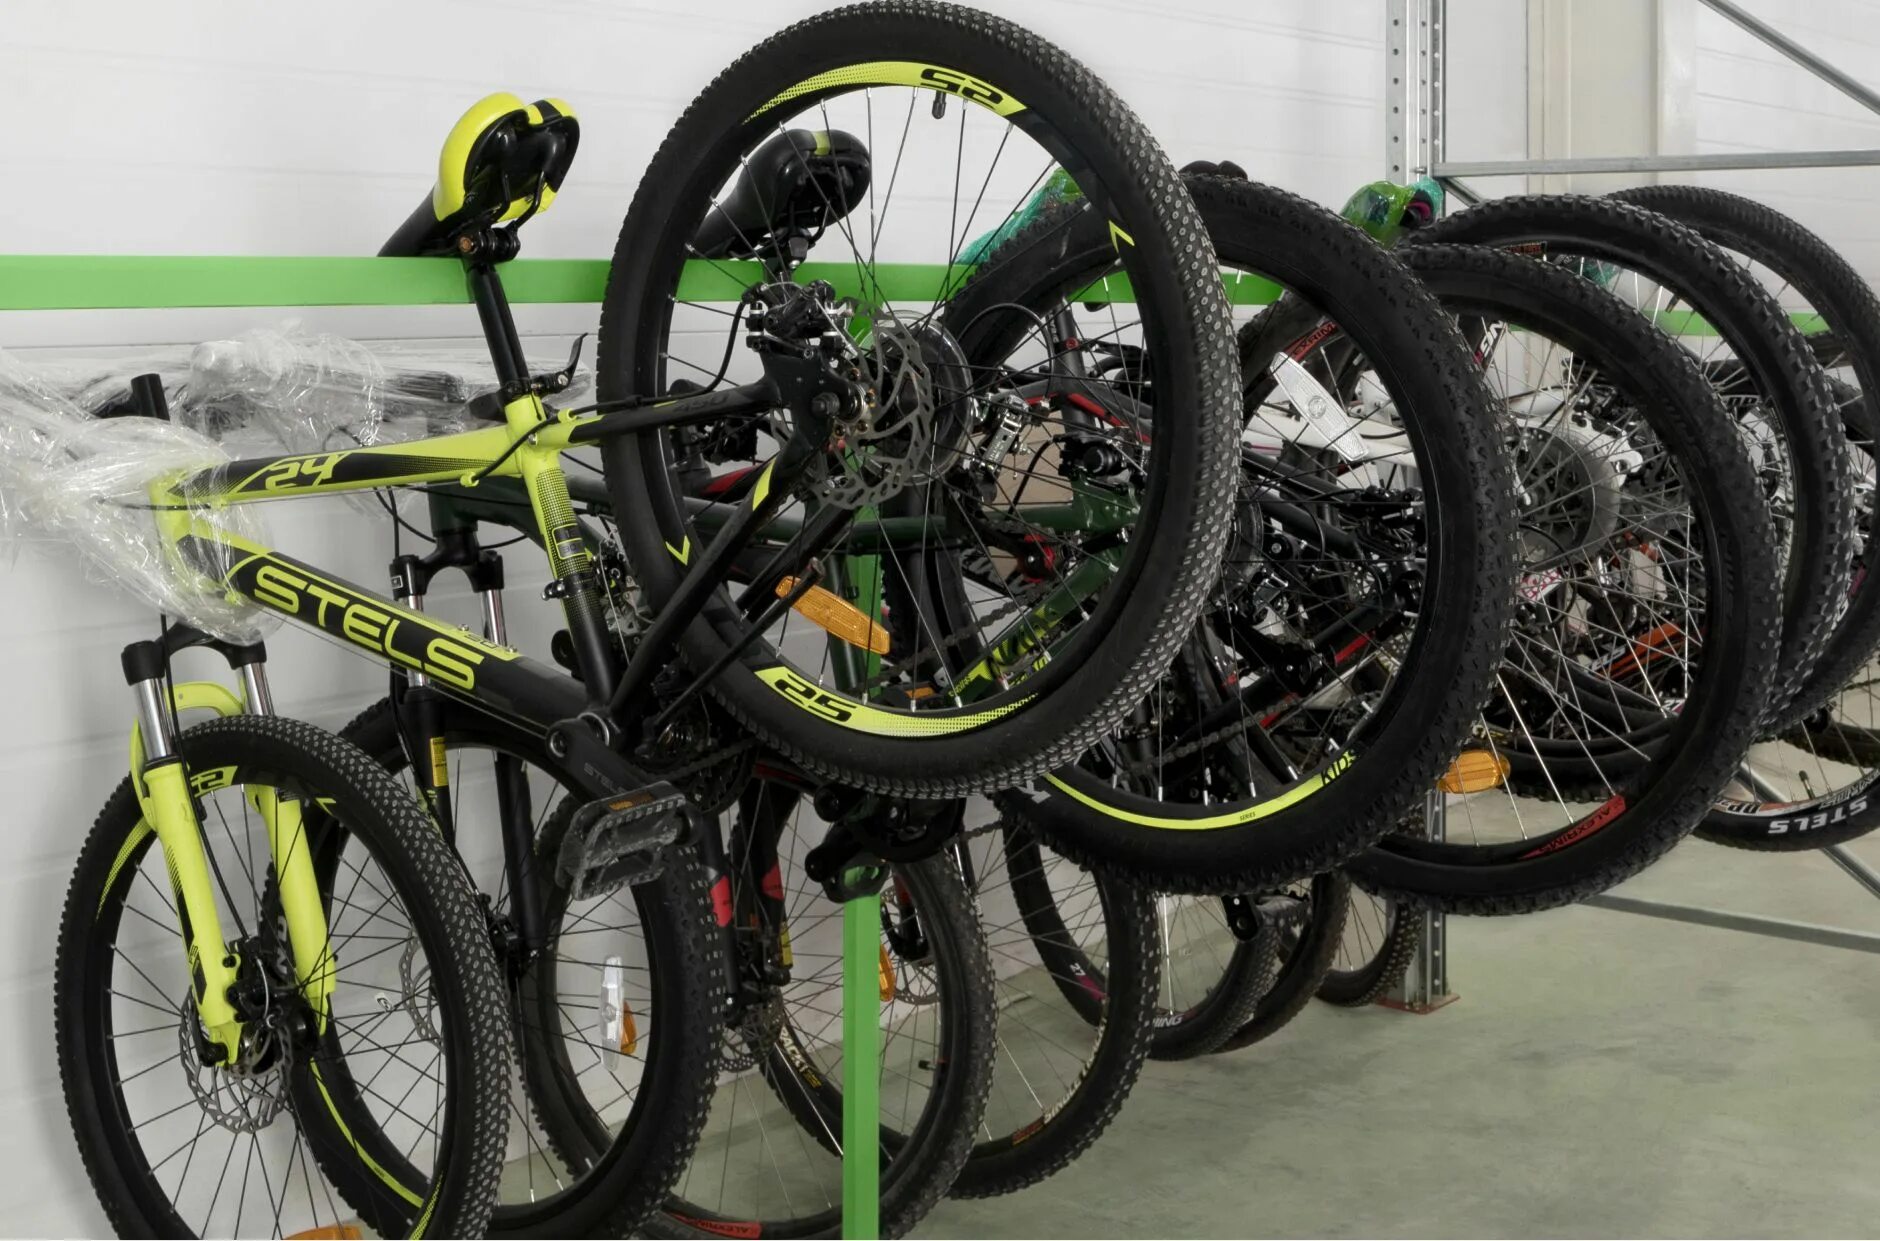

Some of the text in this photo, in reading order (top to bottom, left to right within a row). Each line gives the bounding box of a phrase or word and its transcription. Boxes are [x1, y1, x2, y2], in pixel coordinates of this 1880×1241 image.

[265, 454, 338, 489] 24
[254, 565, 485, 690] STELS
[1320, 749, 1359, 785] KIDS
[1239, 811, 1256, 822] SERIES
[1768, 796, 1868, 834] STELS
